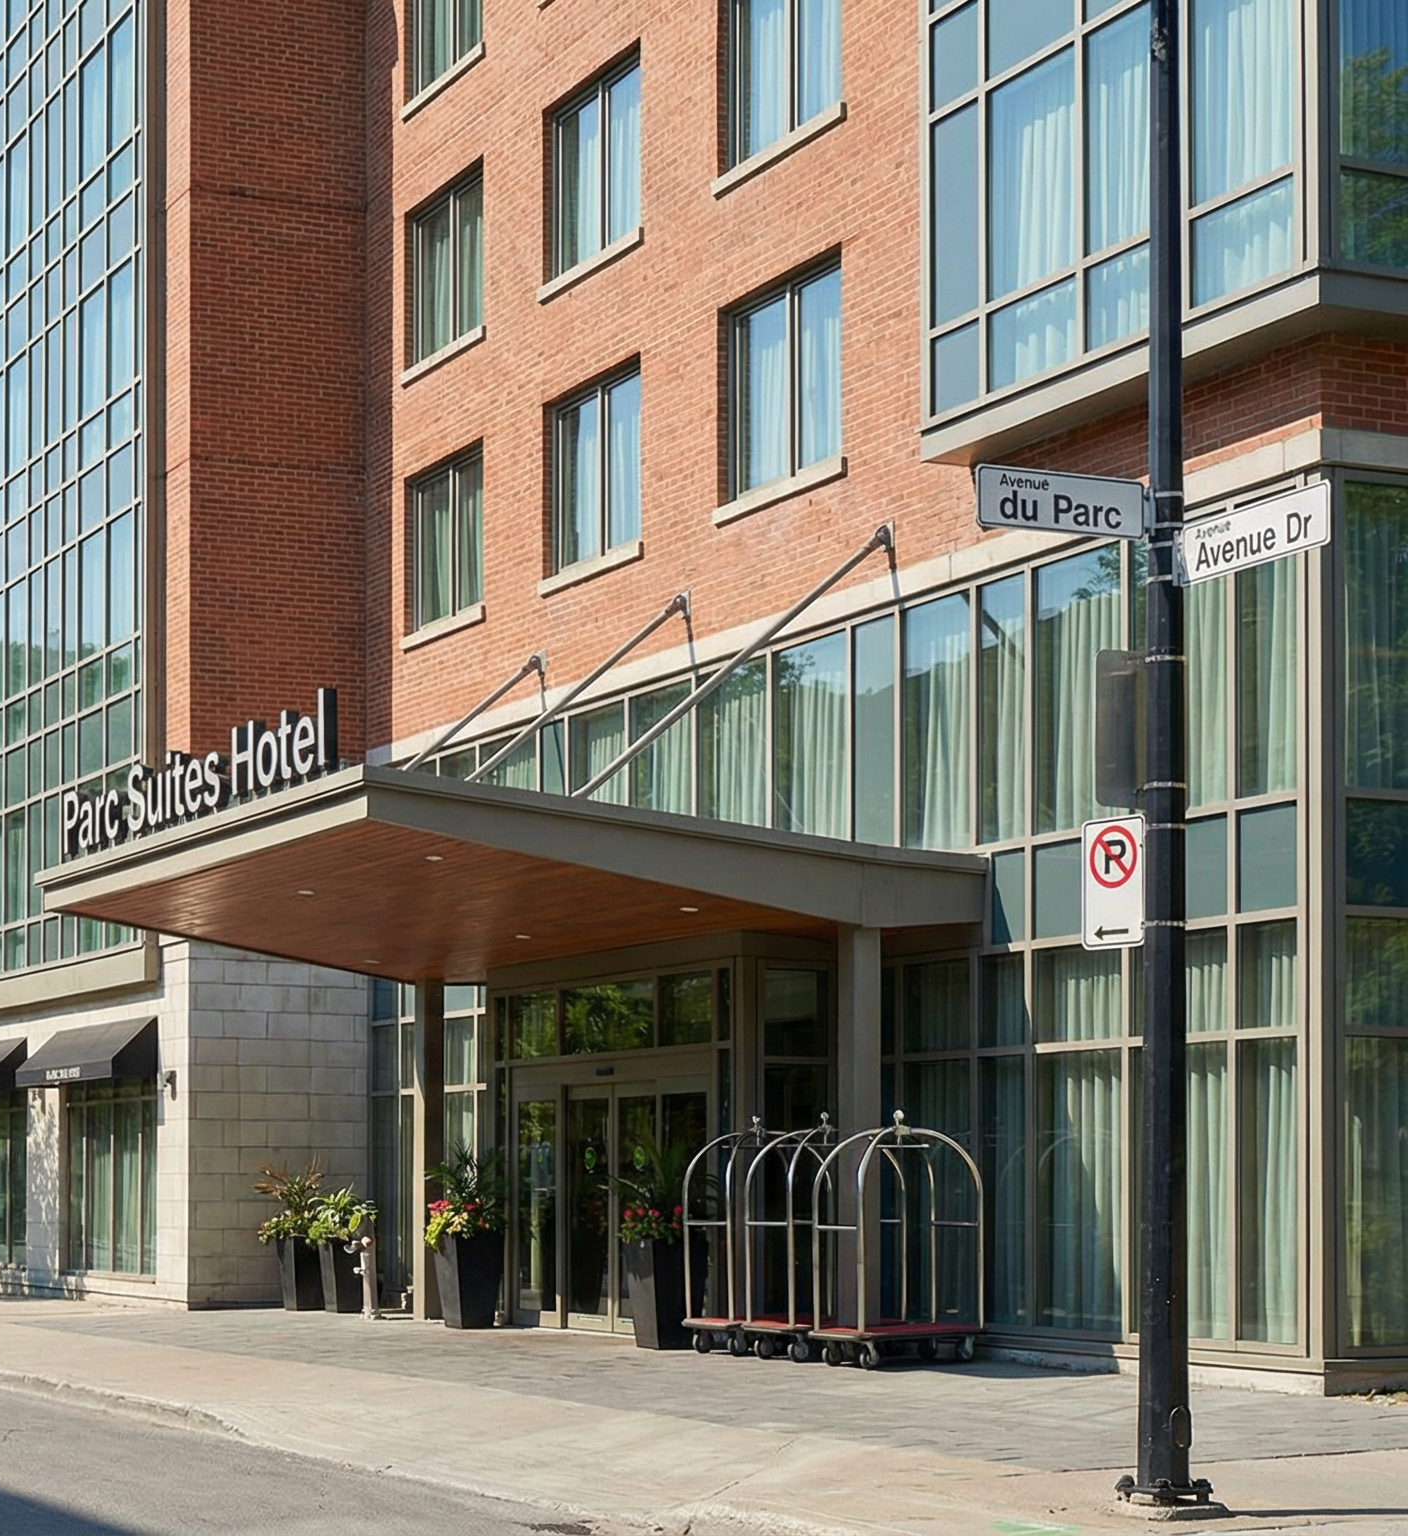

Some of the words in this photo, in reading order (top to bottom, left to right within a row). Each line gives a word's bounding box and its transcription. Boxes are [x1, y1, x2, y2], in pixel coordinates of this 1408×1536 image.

[999, 490, 1038, 521] du
[1053, 493, 1122, 529] Parc
[1195, 527, 1276, 572] Avenue
[1286, 512, 1312, 544] Dr
[63, 789, 119, 854] Parc
[126, 750, 221, 831] Suites
[231, 687, 326, 796] Hotel
